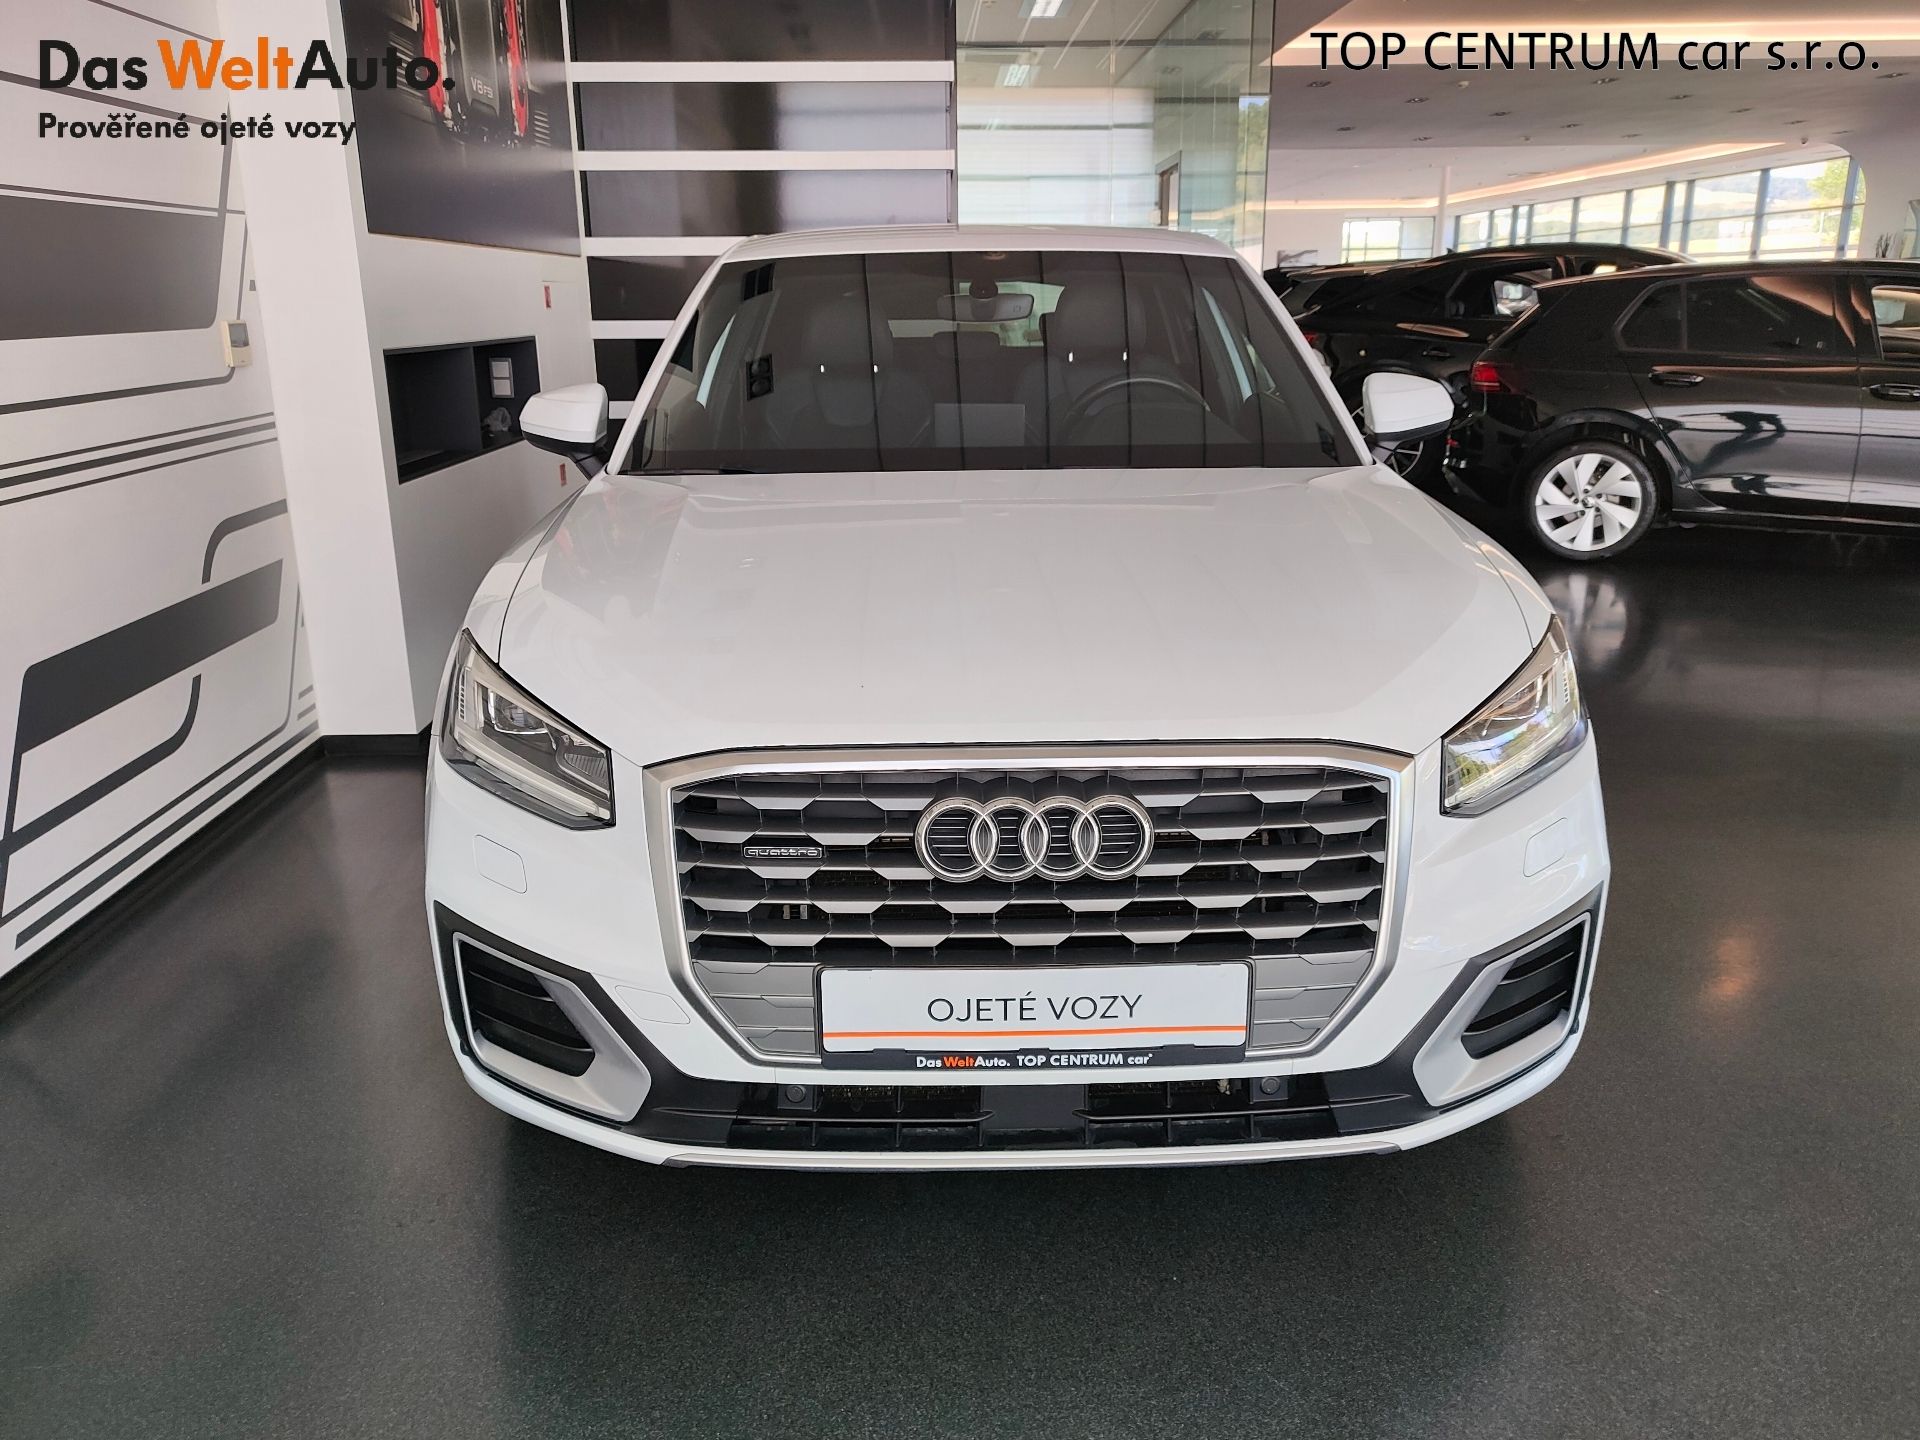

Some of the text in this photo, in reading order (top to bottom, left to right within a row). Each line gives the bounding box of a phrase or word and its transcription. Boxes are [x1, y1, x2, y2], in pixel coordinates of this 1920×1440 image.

[747, 848, 818, 858] quattro
[927, 990, 1143, 1022] OJETÉ VOZY
[916, 1055, 942, 1068] Das
[1016, 1054, 1047, 1067] TOP
[1049, 1053, 1124, 1066] CENTRUM
